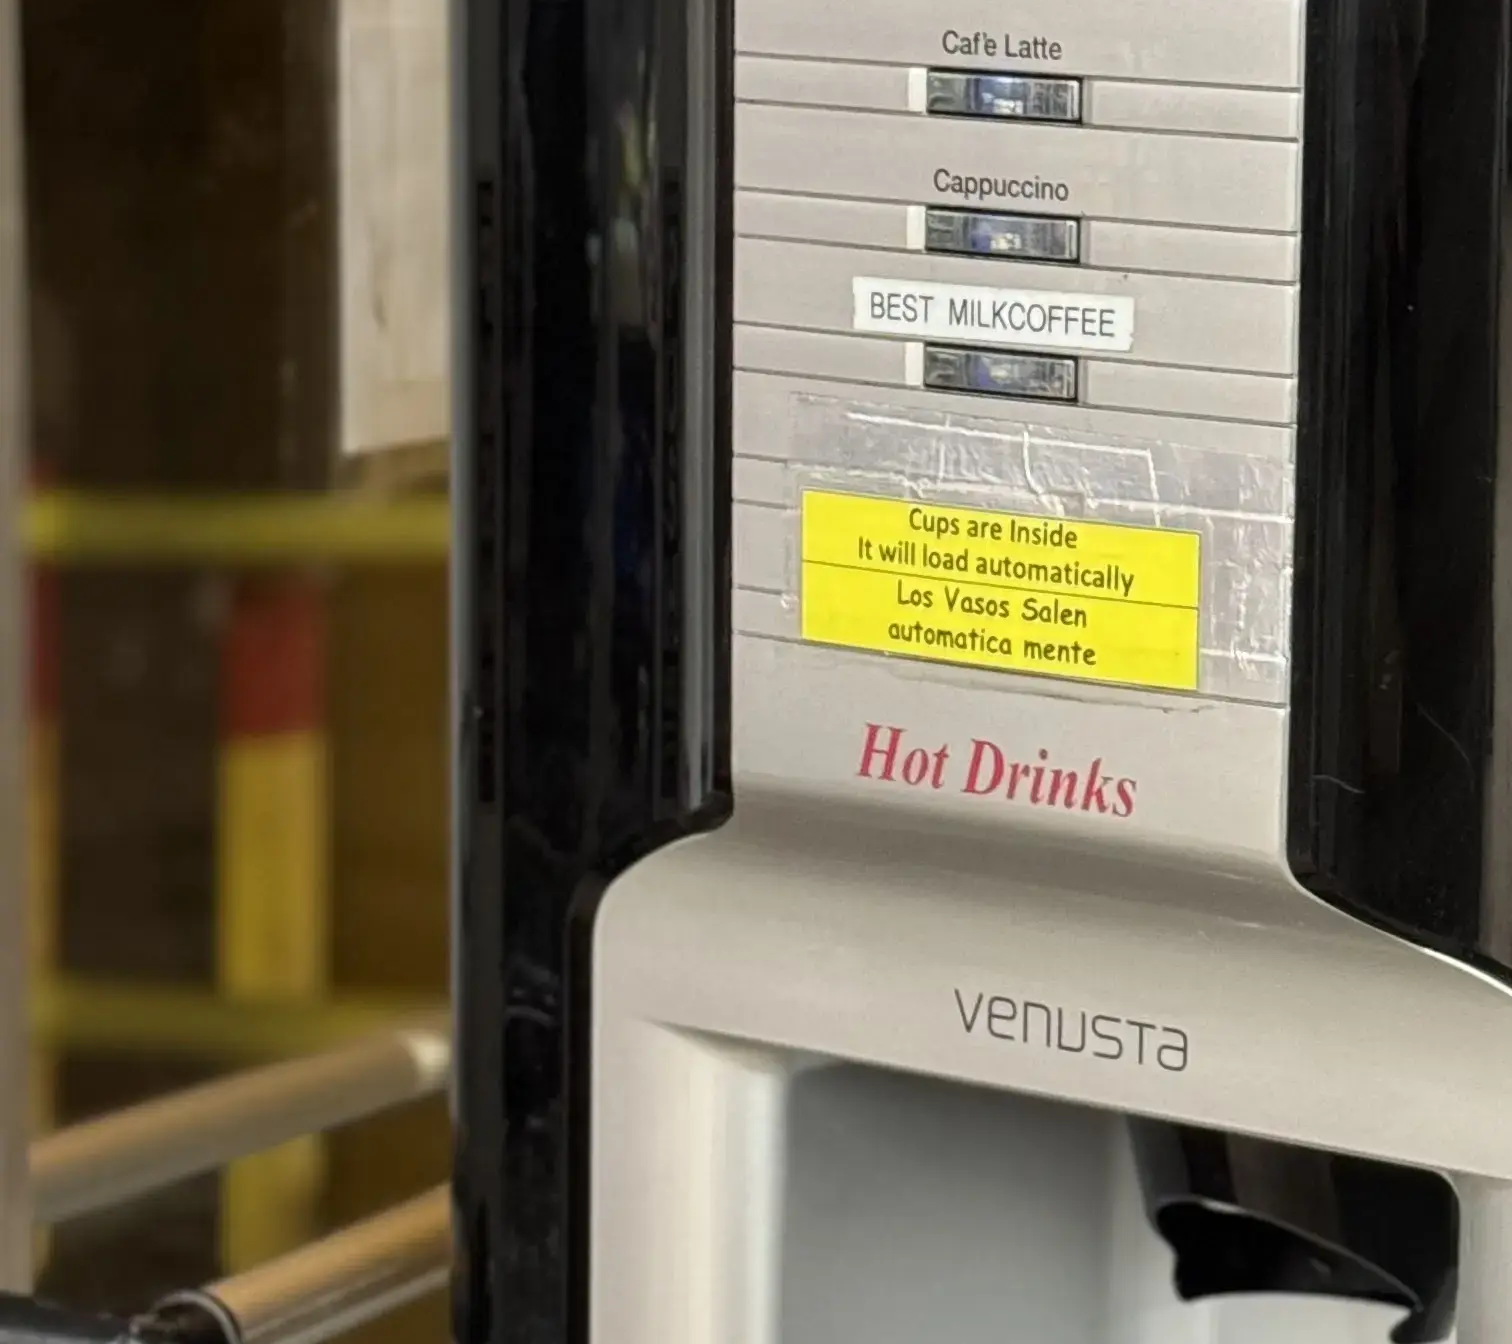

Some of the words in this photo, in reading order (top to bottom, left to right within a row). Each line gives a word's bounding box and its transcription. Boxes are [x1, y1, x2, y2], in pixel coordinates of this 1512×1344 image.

[1004, 33, 1064, 60] Latte
[933, 168, 1070, 203] Cappuccino
[870, 291, 935, 324] BEST
[948, 297, 1118, 338] MILKCOFFEE
[909, 508, 961, 540] Cups
[966, 520, 1004, 541] are
[1010, 519, 1079, 549] Inside
[858, 536, 873, 561] It
[878, 540, 917, 567] will
[923, 543, 970, 573] load
[975, 557, 1136, 598] automatically
[897, 579, 934, 608] Los
[944, 585, 1011, 619] Vasos
[1021, 597, 1089, 629] Salen
[888, 621, 1013, 656] automatica
[1023, 638, 1098, 666] mente
[856, 721, 950, 790] Hot
[961, 737, 1139, 819] Drinks
